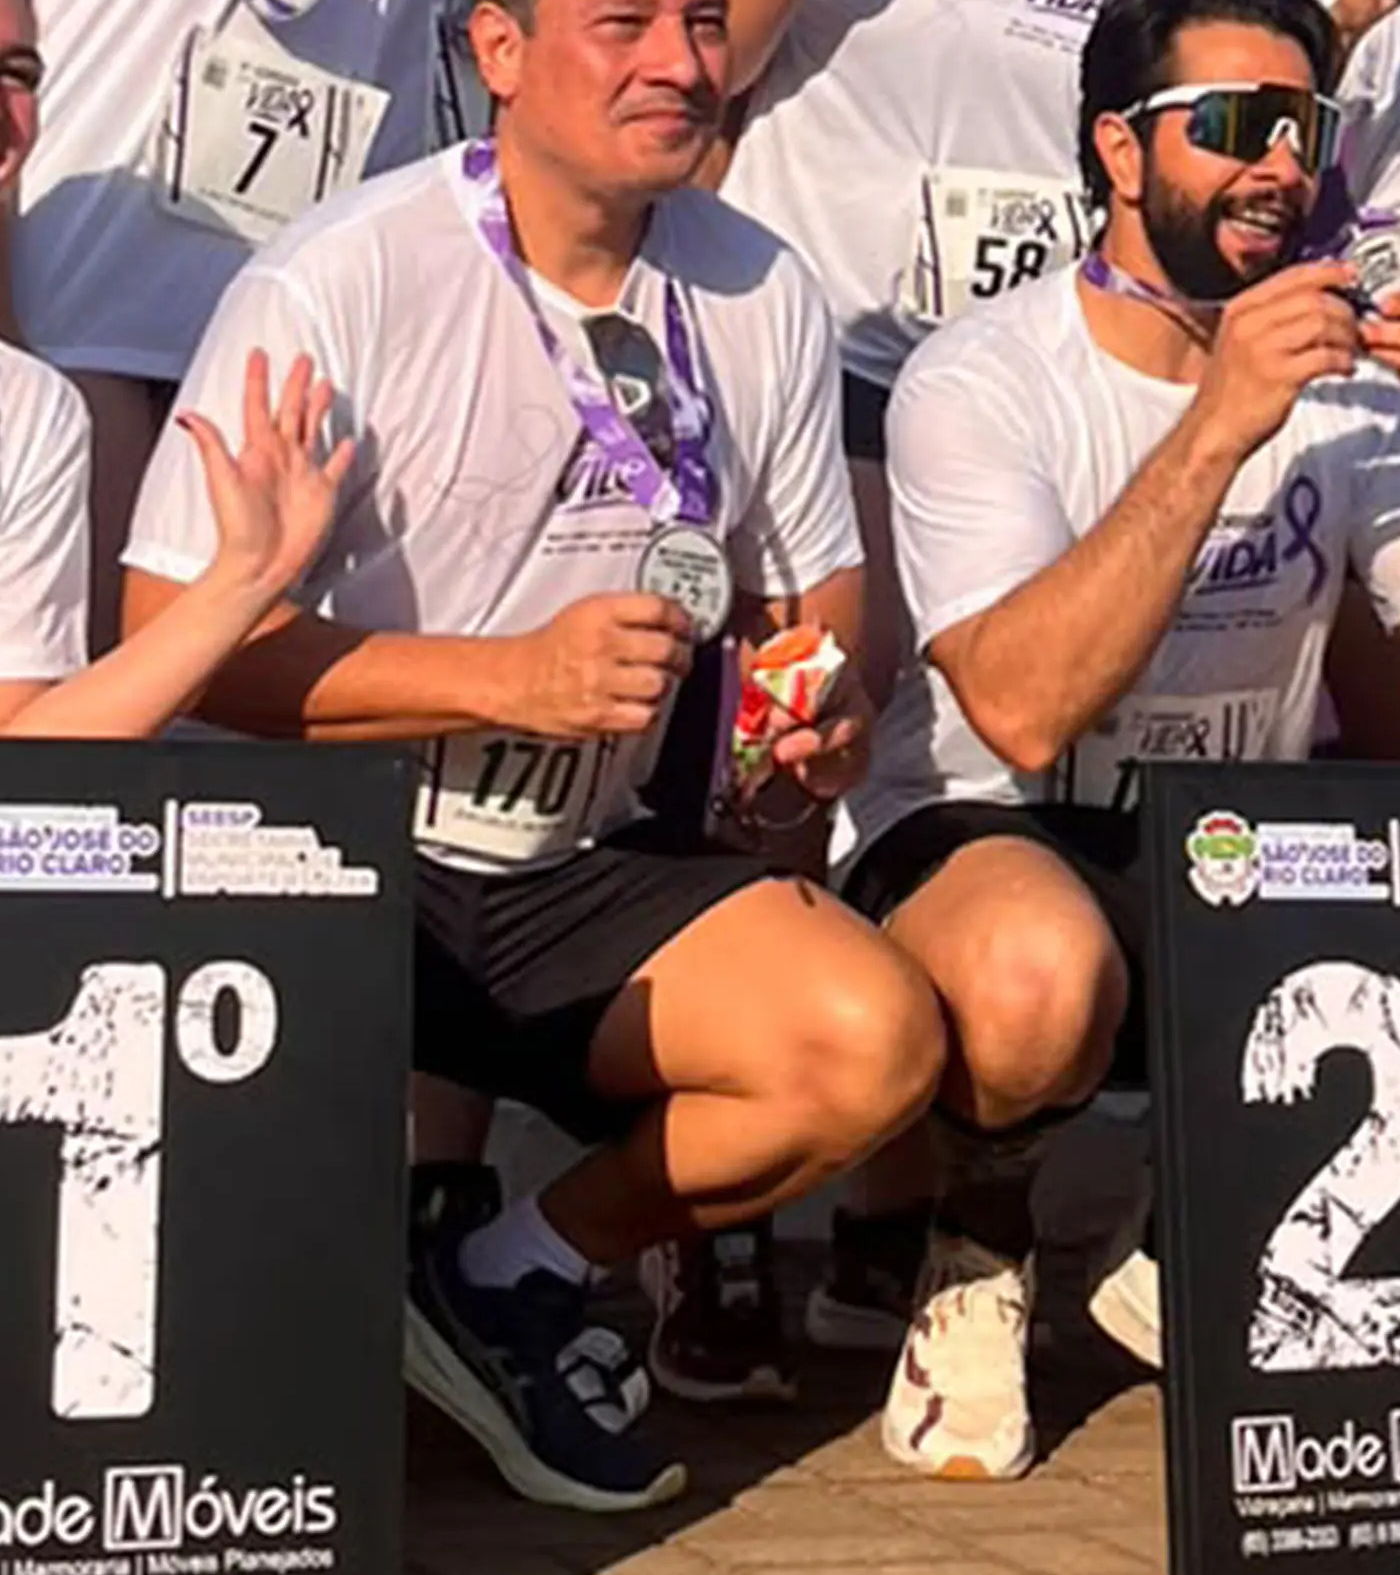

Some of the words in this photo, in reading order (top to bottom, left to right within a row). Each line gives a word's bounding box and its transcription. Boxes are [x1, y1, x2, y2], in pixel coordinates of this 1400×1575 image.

[235, 121, 279, 194] 7
[472, 742, 582, 816] 170
[42, 853, 124, 875] CLARO
[51, 824, 111, 851] JOSÉ
[118, 829, 154, 851] DO
[1231, 1414, 1387, 1493] Made
[103, 1465, 337, 1549] Móveis
[147, 1551, 219, 1575] Móveis
[224, 1547, 334, 1575] Planejados
